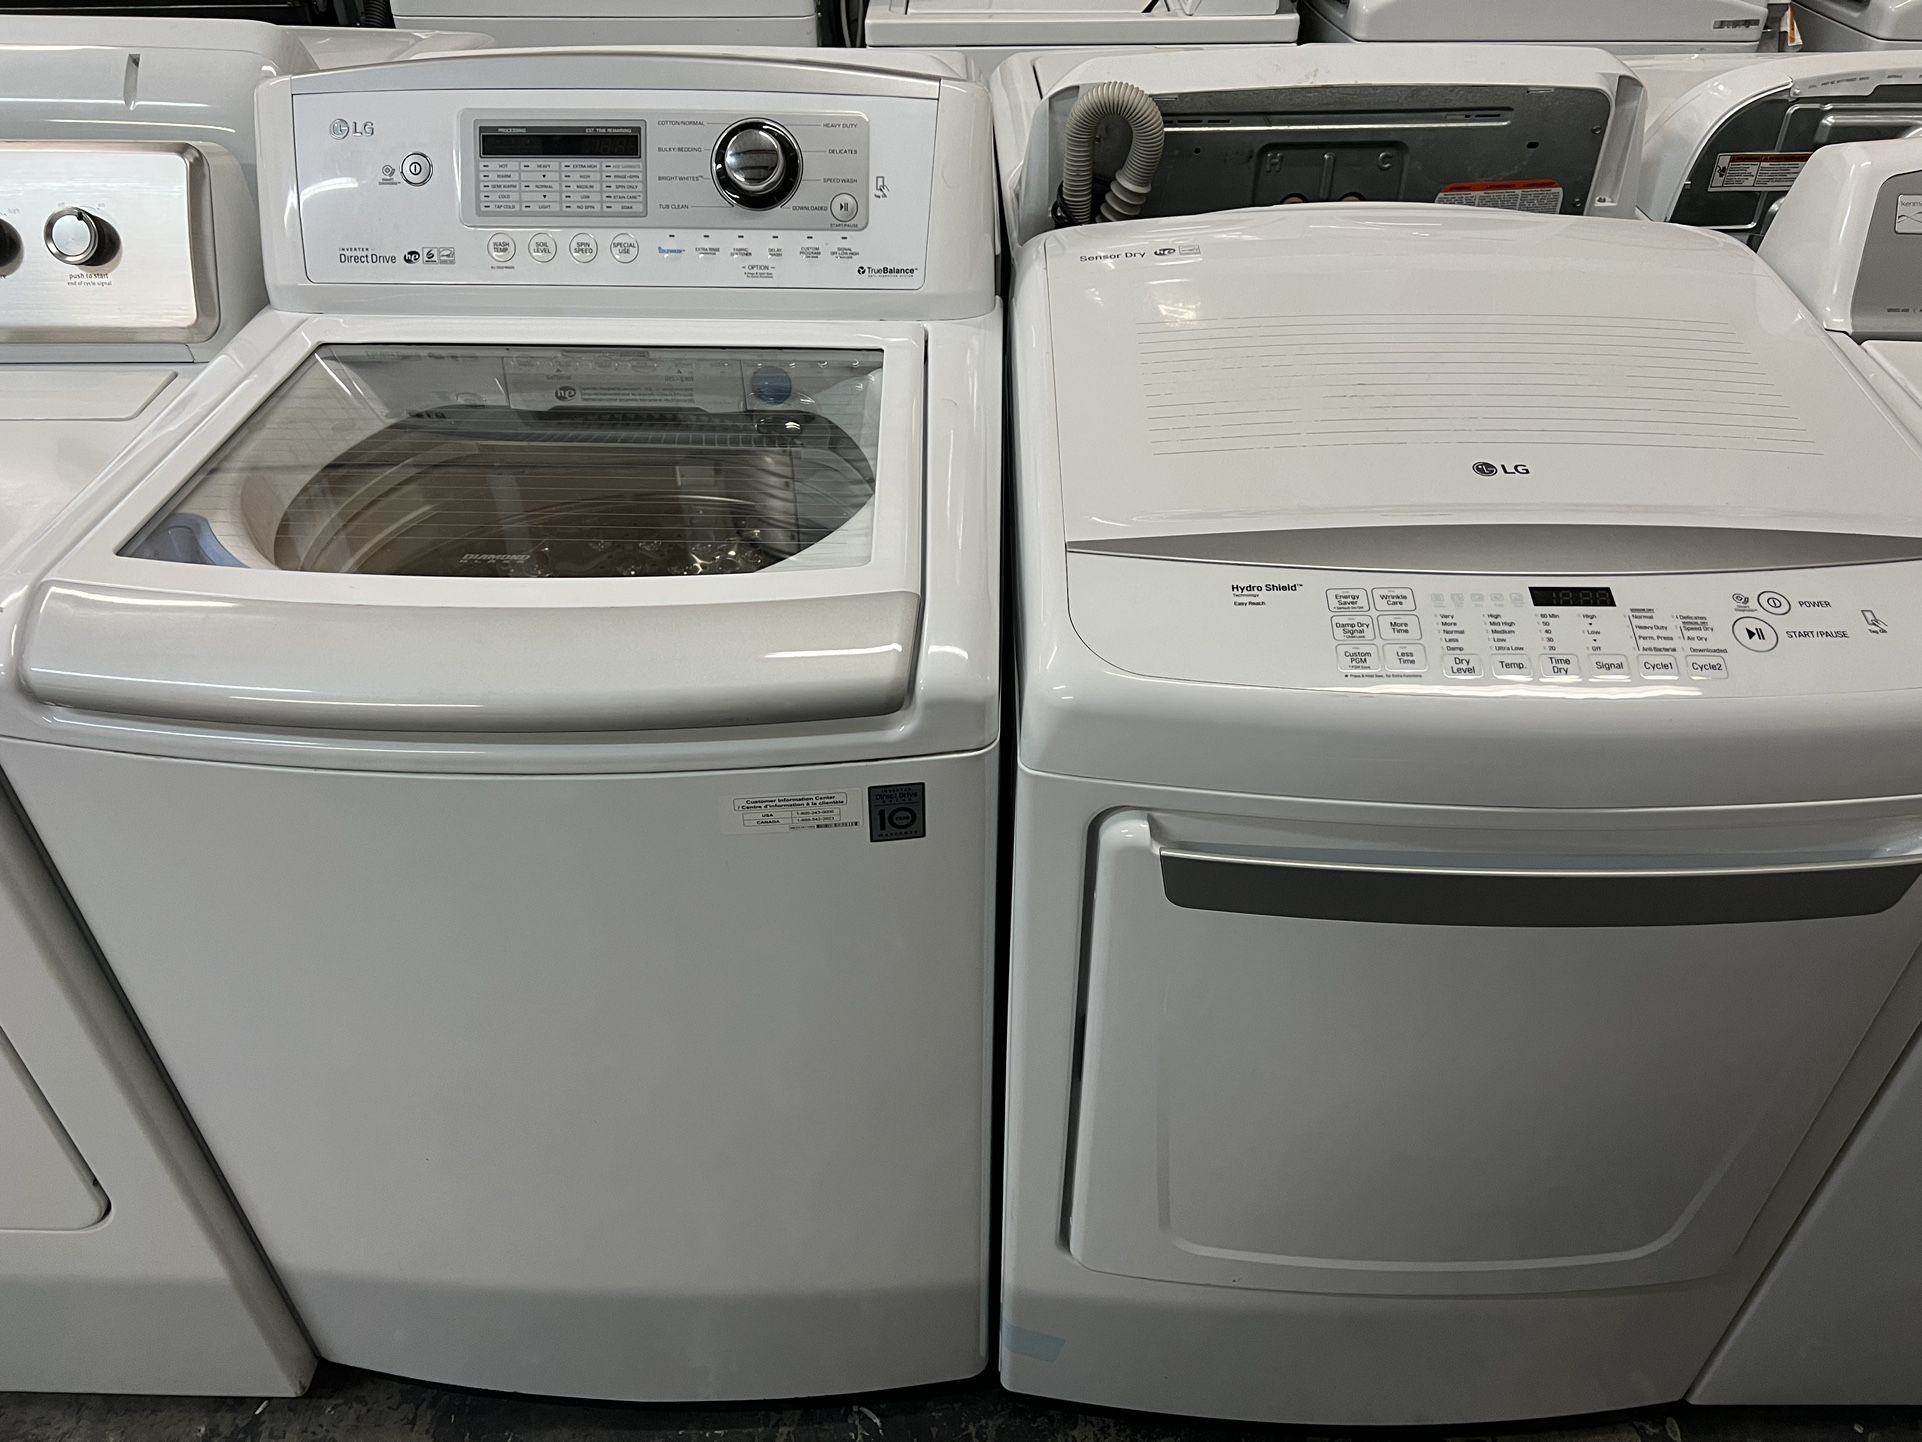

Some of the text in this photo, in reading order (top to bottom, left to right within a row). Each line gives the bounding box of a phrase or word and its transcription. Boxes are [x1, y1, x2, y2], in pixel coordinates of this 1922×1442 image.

[352, 121, 374, 137] LG
[339, 253, 397, 264] Direct Drive
[1079, 251, 1146, 262] Sensor Dry
[69, 273, 85, 281] push
[1500, 463, 1530, 475] LG
[461, 553, 531, 561] DIAMOND
[1231, 584, 1263, 594] Hydro
[1334, 593, 1360, 601] Energy
[1379, 592, 1408, 600] Wrinkle
[1798, 600, 1832, 608] POWER
[1335, 621, 1369, 630] Damp Dry
[1342, 627, 1365, 636] Signal
[1343, 650, 1372, 658] Custom
[1395, 650, 1414, 658] Less
[1397, 657, 1416, 665] Time
[1453, 656, 1470, 666] Dry
[1498, 660, 1527, 670] Temp.
[1548, 656, 1571, 665] Time
[1450, 665, 1475, 674] Level
[1552, 665, 1568, 675] Dry
[1595, 661, 1624, 671] Signal
[1643, 660, 1673, 671] Cycle1
[1691, 662, 1723, 672] Cycle2
[898, 791, 918, 799] Drive
[877, 806, 917, 832] 10
